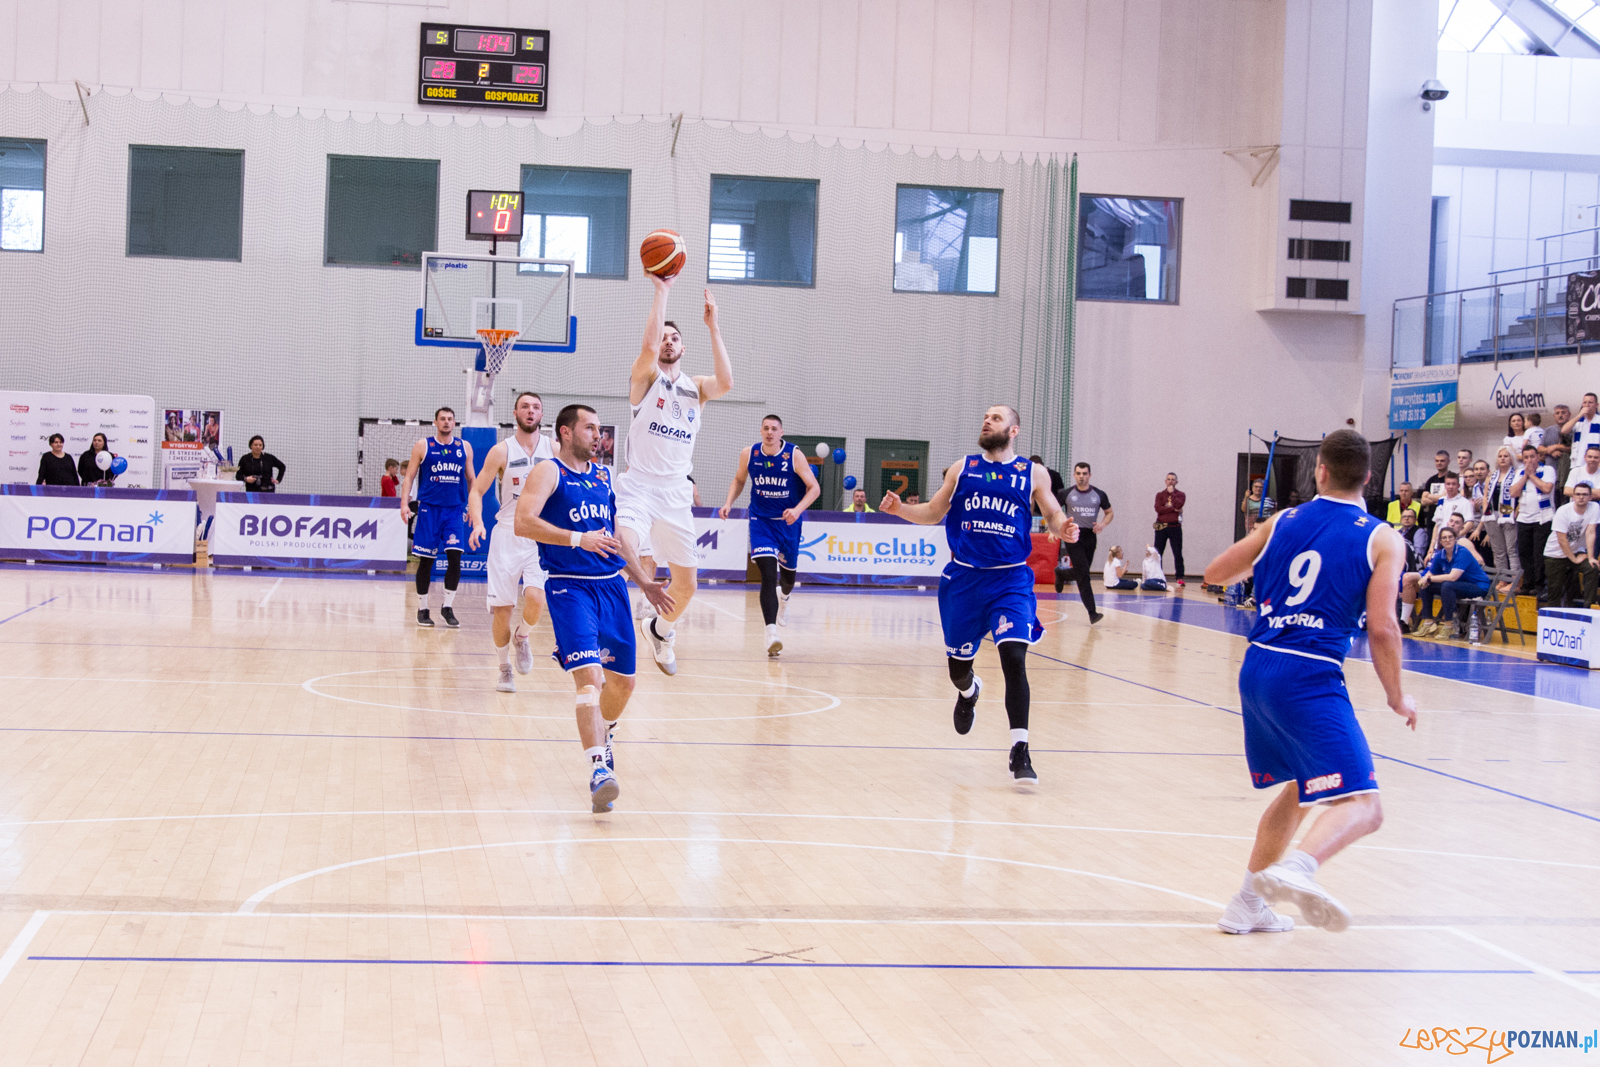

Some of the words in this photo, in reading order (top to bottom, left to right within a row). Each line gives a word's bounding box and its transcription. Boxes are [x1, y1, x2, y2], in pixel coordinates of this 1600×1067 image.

[478, 34, 511, 52] 1:04
[525, 37, 534, 50] 5
[431, 61, 456, 79] 28
[478, 63, 490, 78] 2
[515, 66, 540, 84] 29
[426, 86, 457, 98] GOŚCIE
[484, 90, 539, 103] GOSPODARZE
[490, 194, 519, 211] 1:04
[494, 210, 511, 232] 0
[1496, 388, 1546, 409] Budchem
[672, 401, 682, 420] 8
[456, 449, 463, 458] 6
[431, 461, 463, 474] GÓRNIK
[781, 461, 788, 472] 2
[754, 474, 788, 487] GÓRNIK
[1010, 474, 1027, 491] 11
[964, 492, 1019, 518] GÓRNIK
[26, 516, 155, 543] POZnan
[239, 514, 378, 541] BIOFARM
[972, 520, 1016, 534] TRANS.EU
[283, 542, 333, 550] PRODUCENT
[338, 542, 366, 551] LEKÓW
[826, 535, 936, 557] funclub
[436, 560, 488, 569] SPRTSY
[827, 555, 868, 563] biuro
[873, 556, 936, 566] podróży
[1284, 550, 1322, 607] 9
[1542, 628, 1582, 650] POZnan
[567, 650, 598, 663] RONAL
